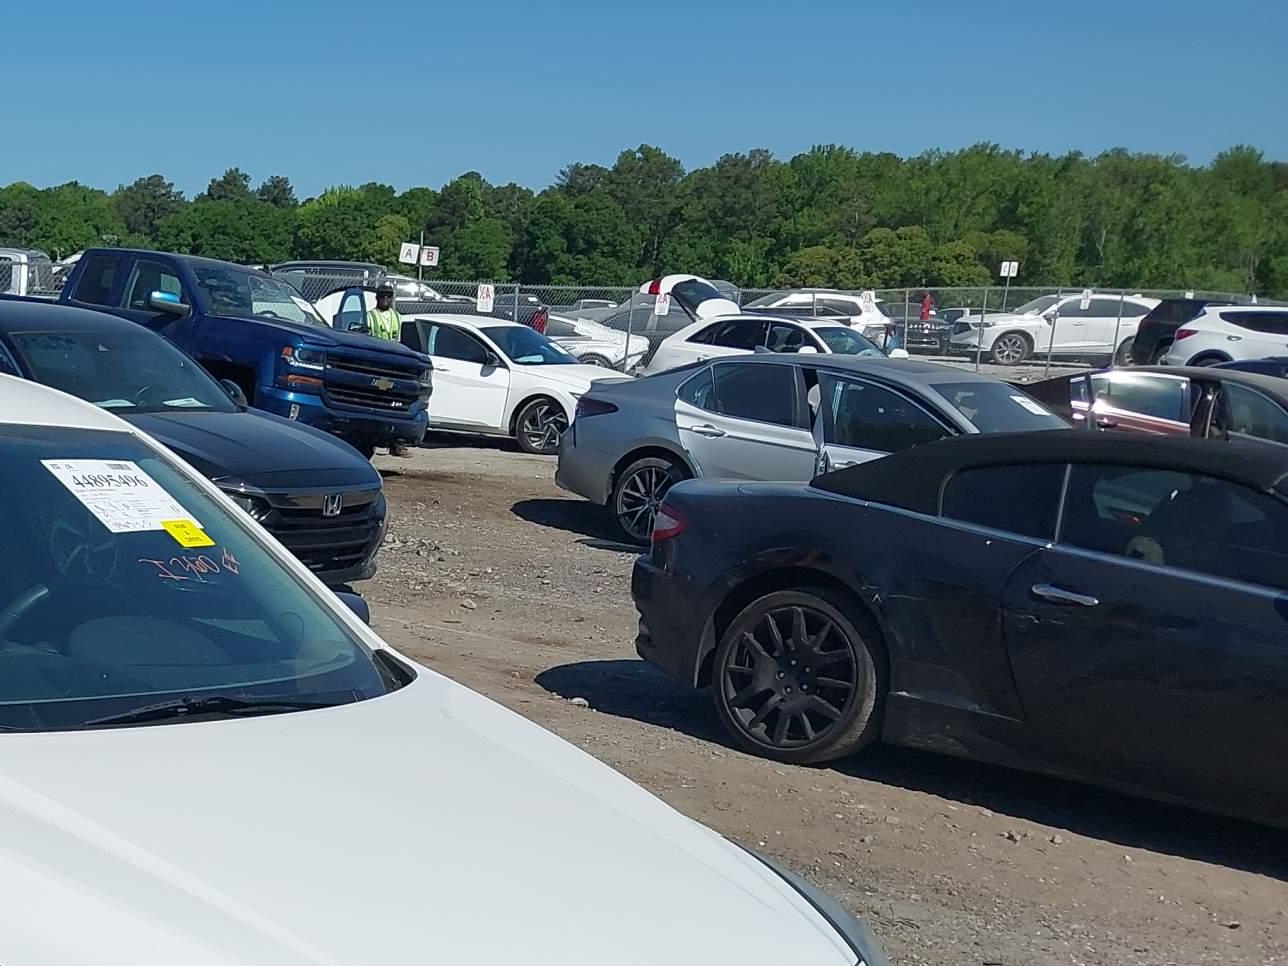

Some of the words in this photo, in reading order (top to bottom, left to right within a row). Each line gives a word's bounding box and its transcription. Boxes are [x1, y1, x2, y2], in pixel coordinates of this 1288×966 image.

[404, 248, 413, 259] A
[426, 251, 434, 262] B
[72, 474, 149, 489] 44895496
